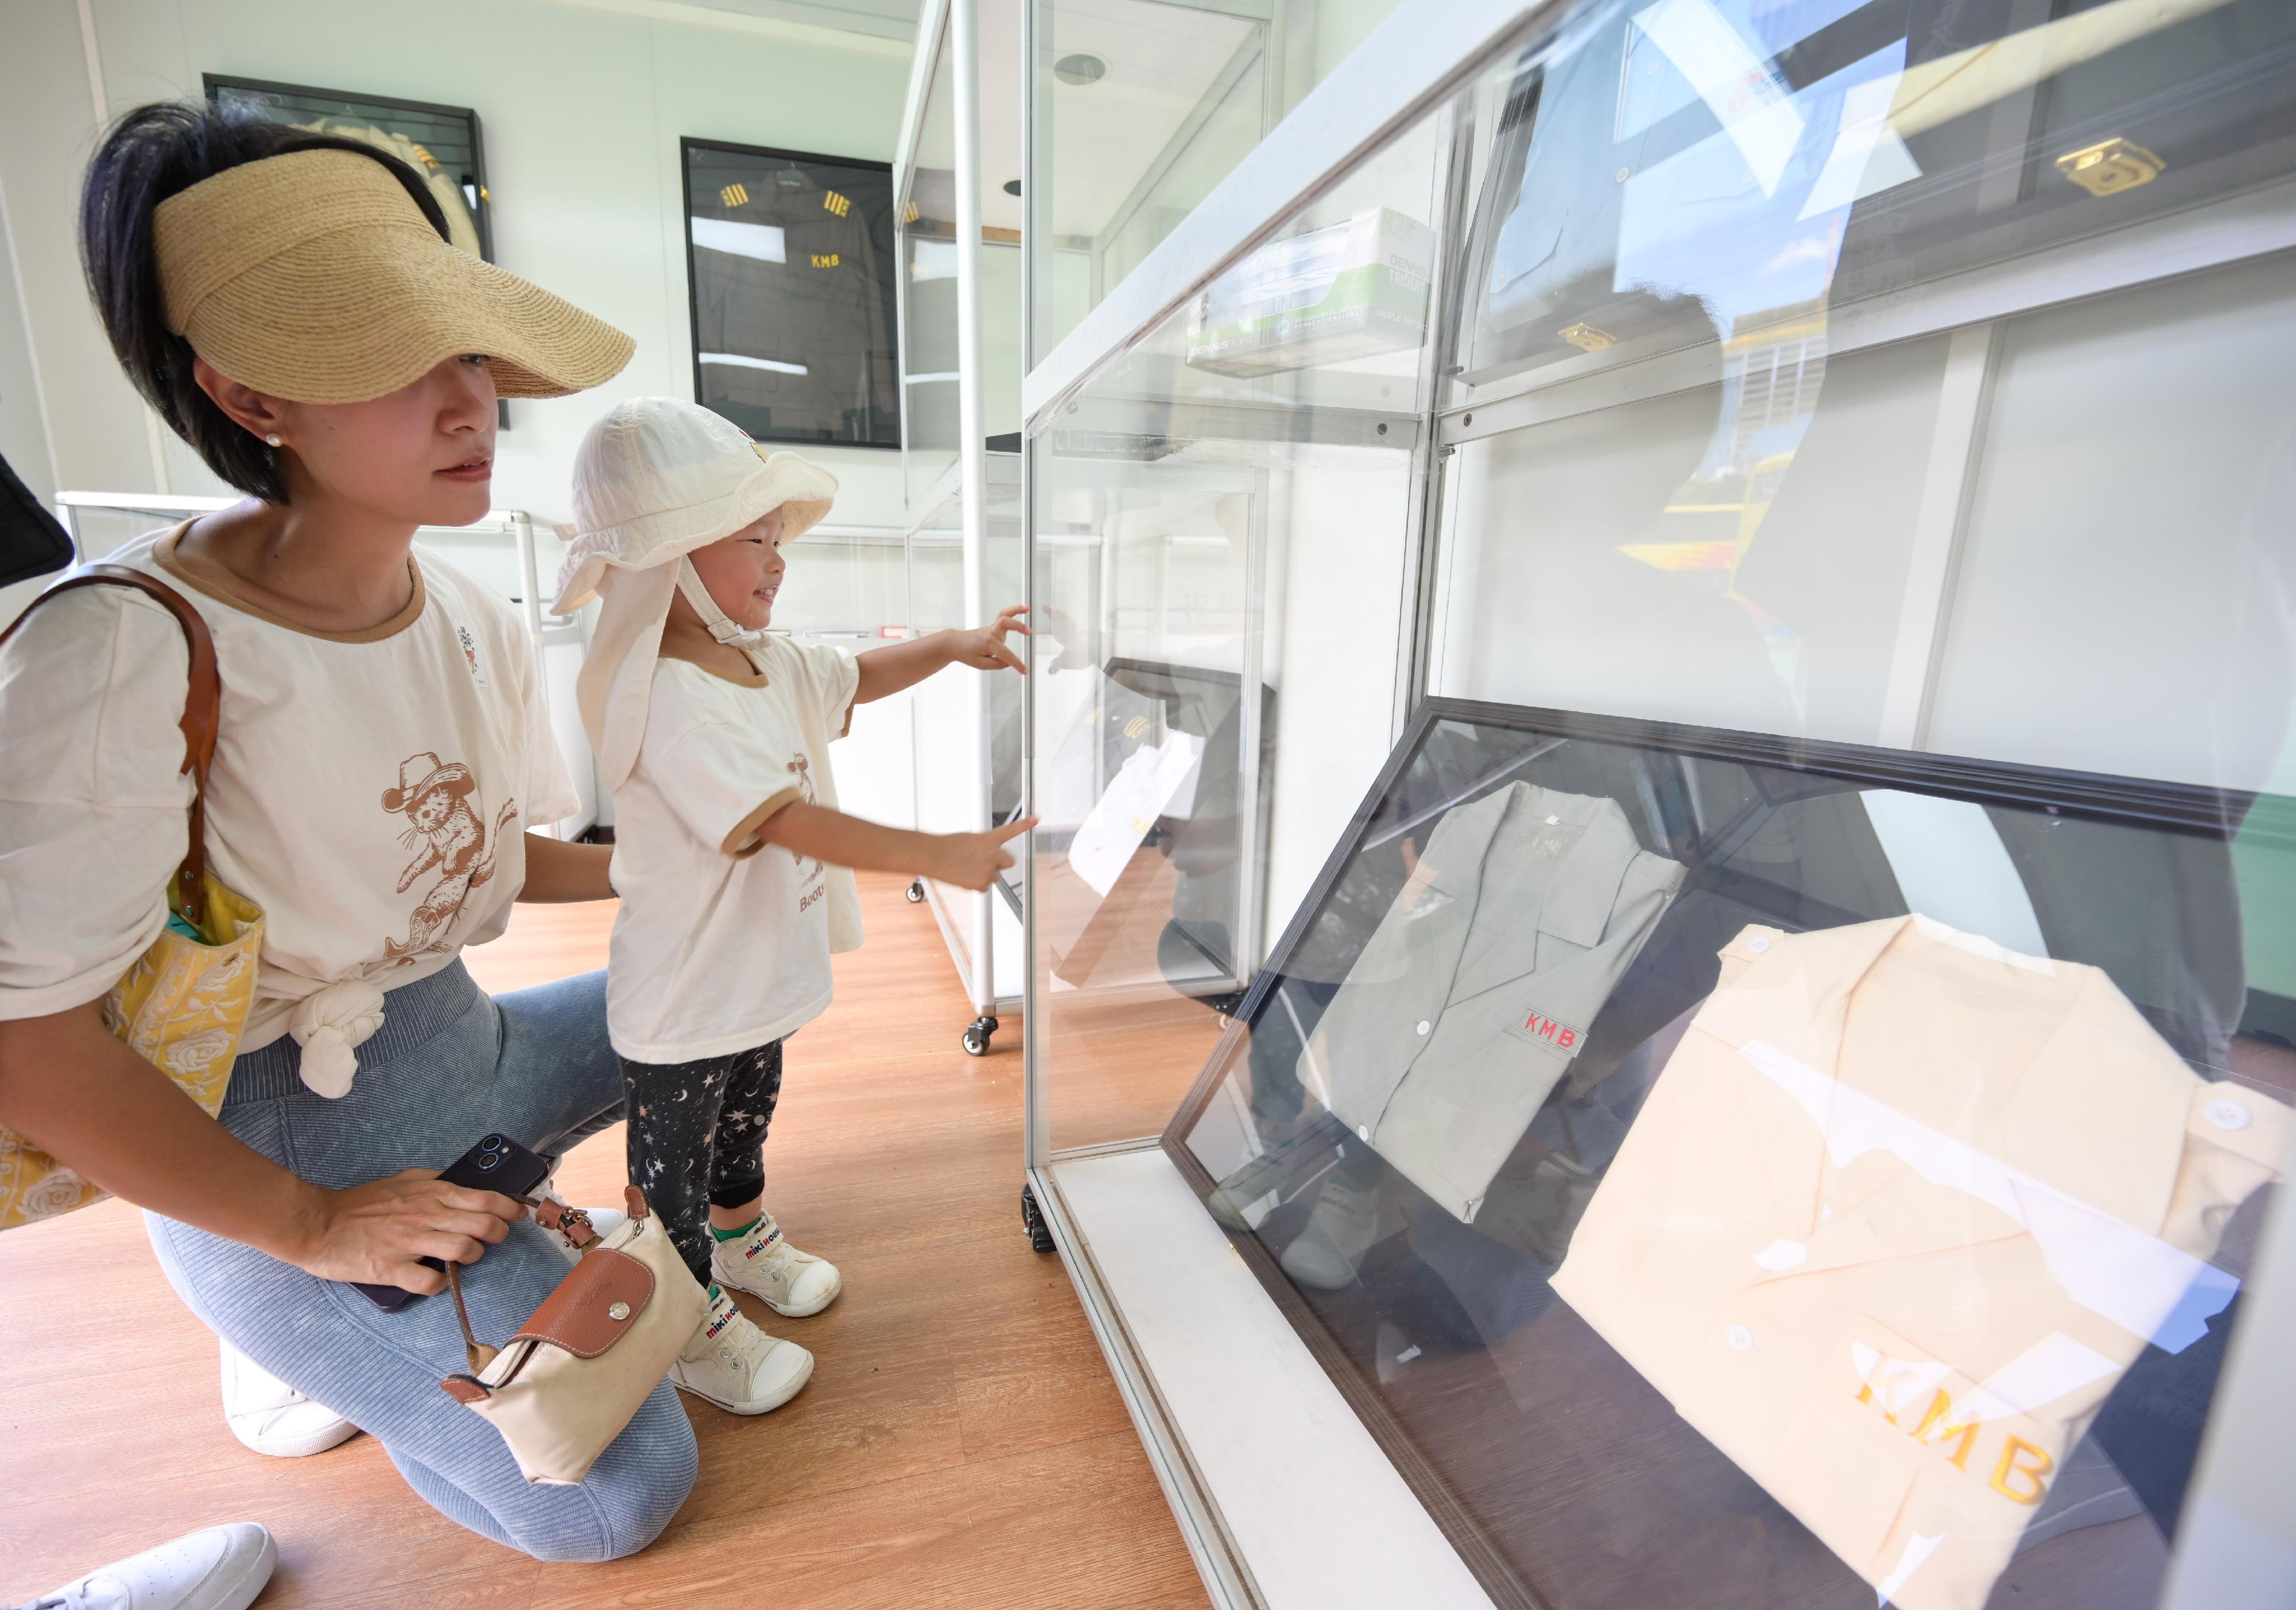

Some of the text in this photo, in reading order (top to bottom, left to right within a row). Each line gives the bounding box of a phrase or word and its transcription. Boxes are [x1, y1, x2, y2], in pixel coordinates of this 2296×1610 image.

[811, 254, 839, 268] KMB
[1389, 253, 1427, 279] DENNIS
[1389, 268, 1425, 295] TRIDENT
[1377, 308, 1401, 323] DUPLE
[1192, 335, 1253, 355] DENNIS TRIDENT
[1525, 1012, 1575, 1048] KMB
[745, 1227, 780, 1259] mikiHOUS
[1854, 1350, 2053, 1506] KMB
